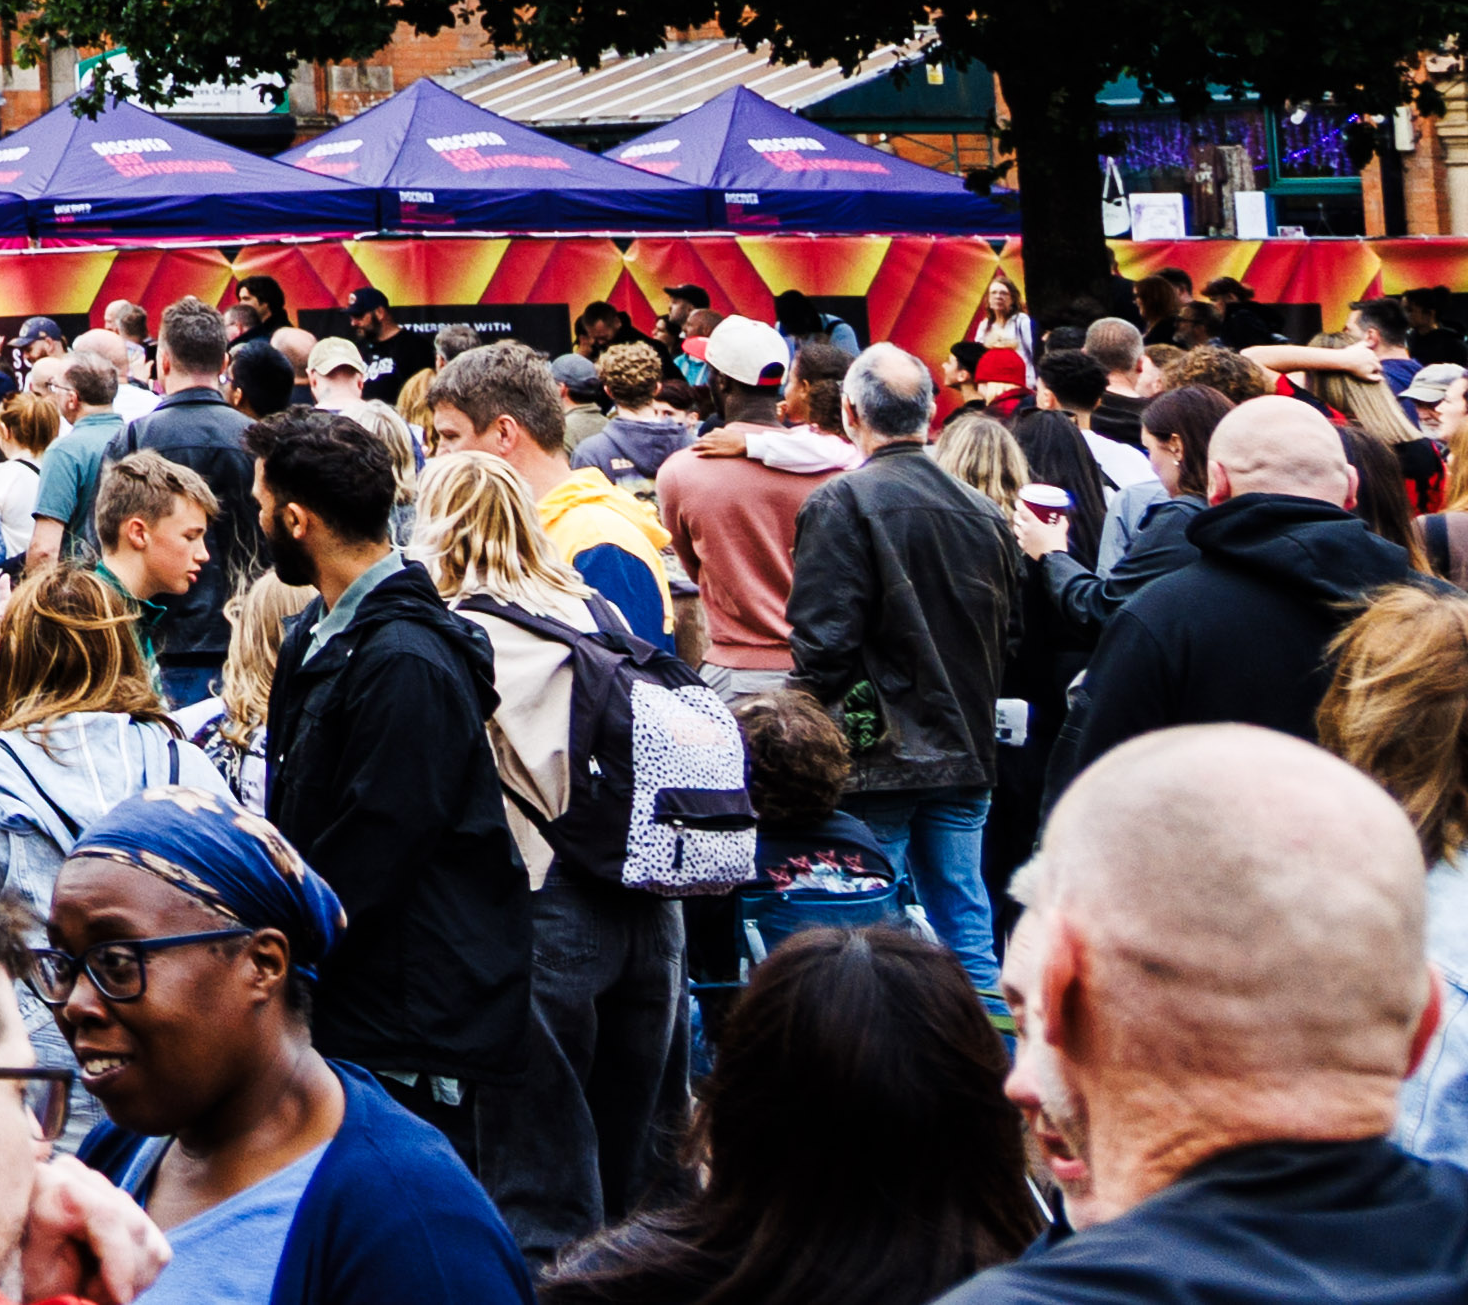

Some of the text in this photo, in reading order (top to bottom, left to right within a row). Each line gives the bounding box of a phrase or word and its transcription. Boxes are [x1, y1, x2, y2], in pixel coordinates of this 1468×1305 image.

[91, 138, 172, 156] DISCOVER
[426, 131, 507, 152] DISCOVER
[474, 322, 511, 332] WITH
